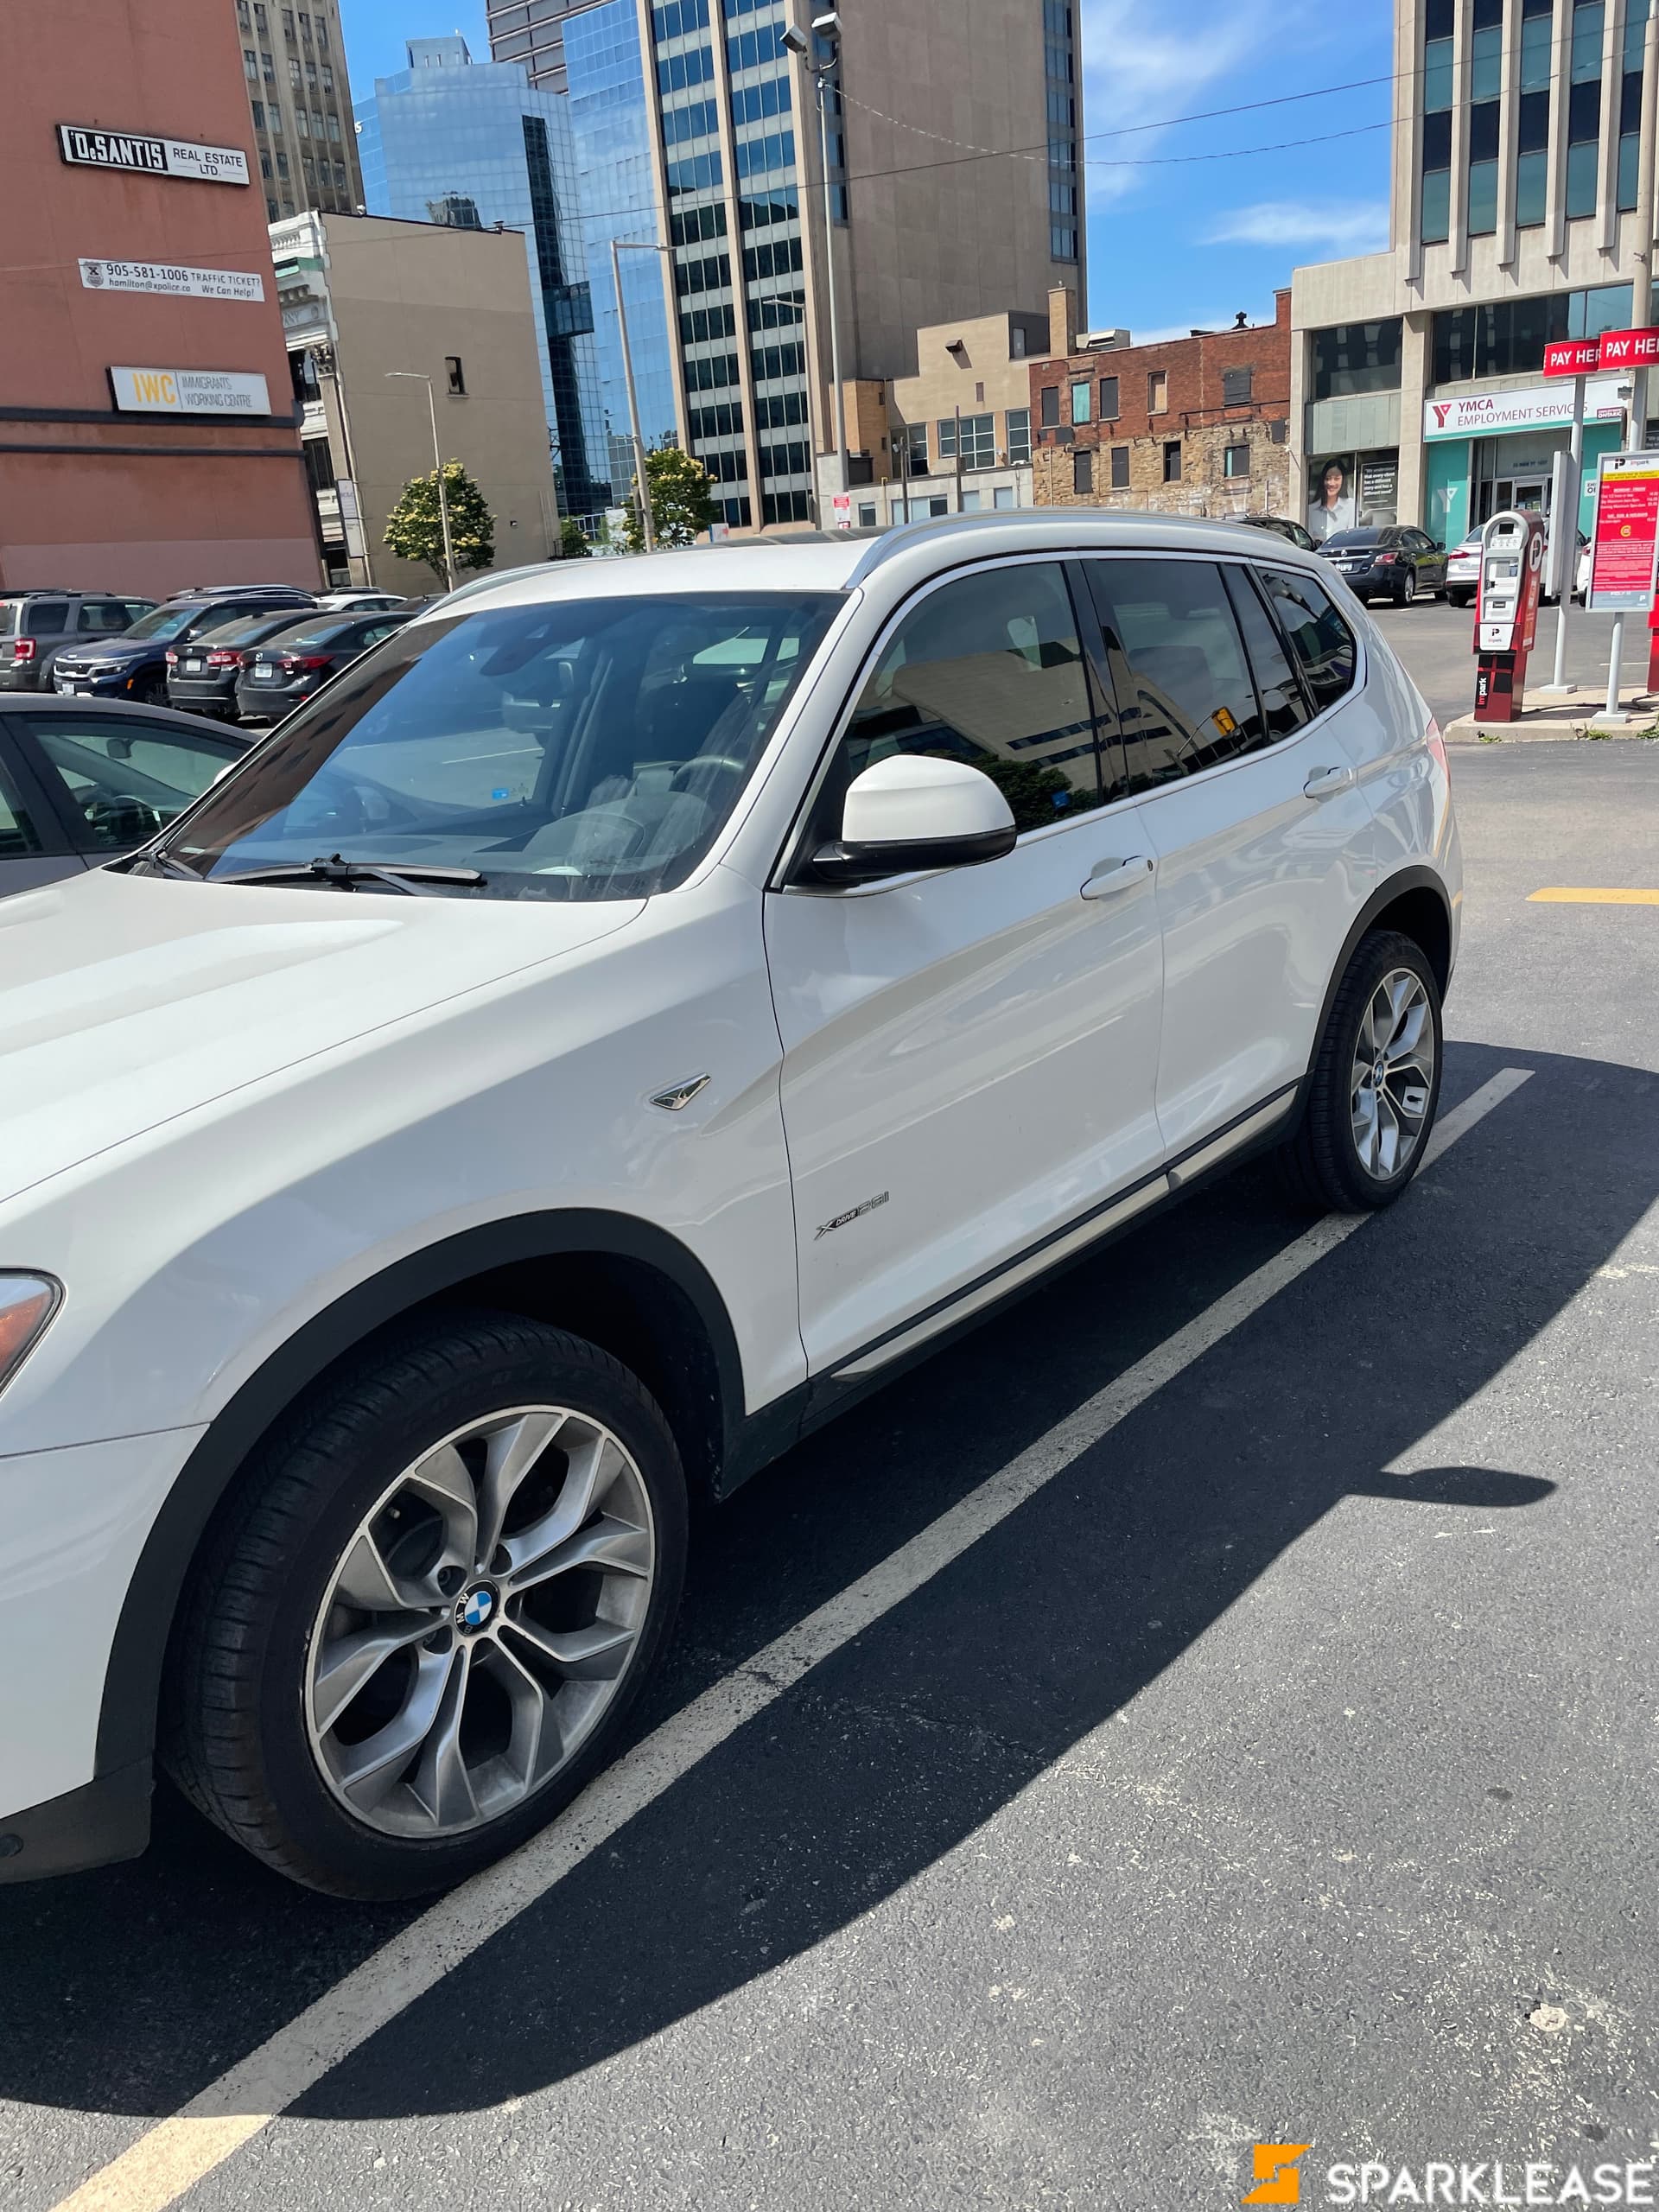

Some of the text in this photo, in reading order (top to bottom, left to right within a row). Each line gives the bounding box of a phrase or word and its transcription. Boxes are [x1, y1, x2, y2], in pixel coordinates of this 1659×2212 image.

[173, 148, 243, 167] REAL ESTATE
[200, 164, 221, 176] LTD.
[106, 264, 189, 282] 905-581-1006
[201, 285, 254, 298] We Can Help!
[1606, 337, 1659, 358] PAY HE
[1550, 351, 1573, 366] PAY
[132, 372, 176, 404] IWC
[181, 376, 232, 390] IMMIGRANTS
[185, 393, 224, 407] WORKING
[1458, 398, 1494, 411] YMCA
[1458, 401, 1587, 427] EMPLOYMENT SERVICS
[1478, 677, 1487, 705] impark
